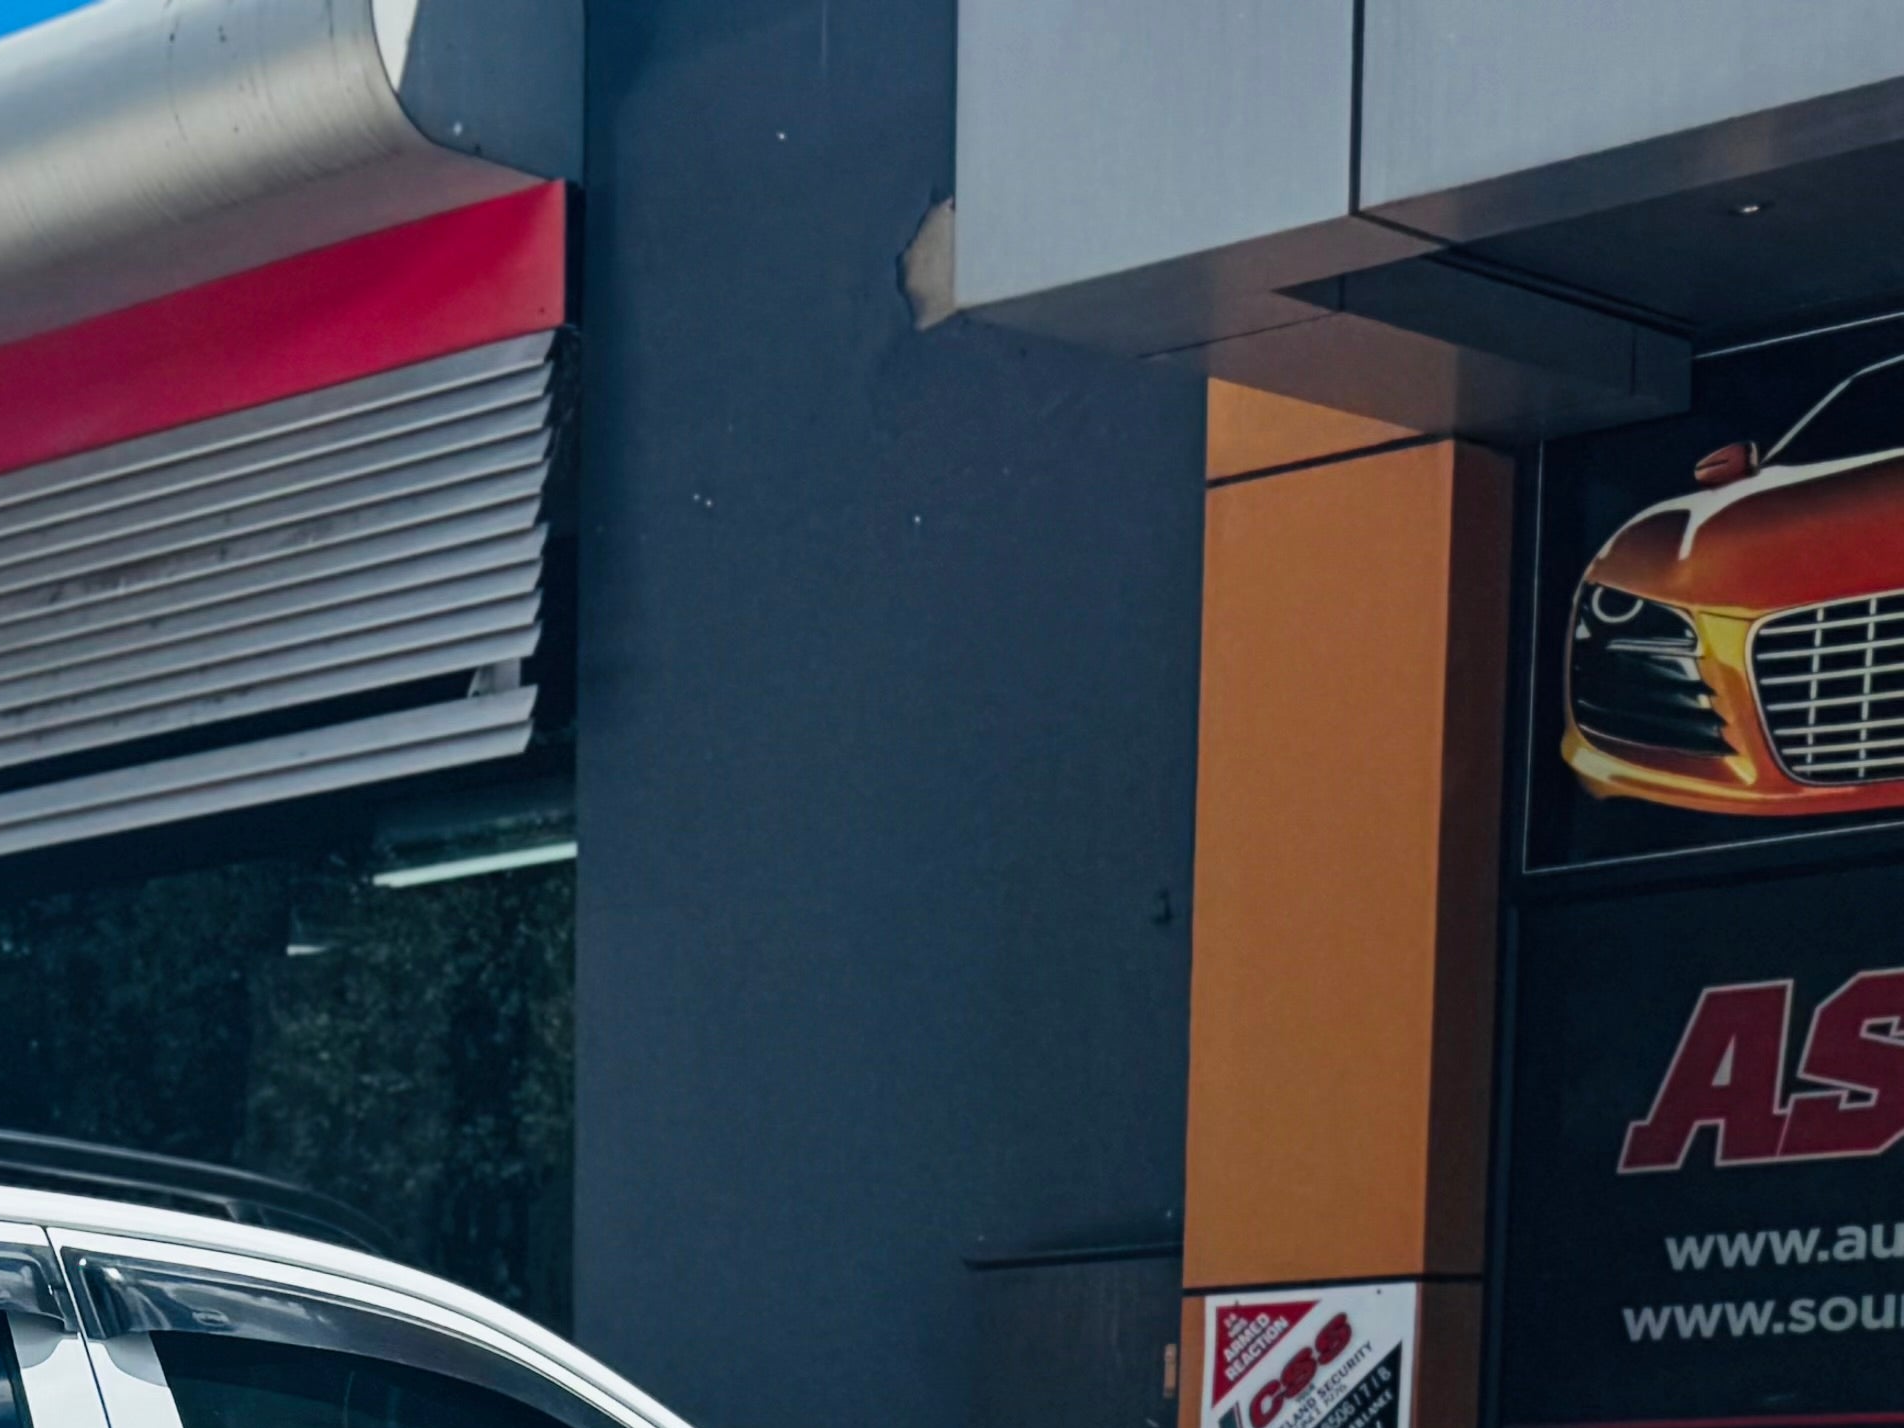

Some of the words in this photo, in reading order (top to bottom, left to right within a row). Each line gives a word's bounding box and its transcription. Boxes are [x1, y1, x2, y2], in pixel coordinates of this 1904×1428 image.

[1223, 1313, 1270, 1362] ARMED
[1622, 1293, 1904, 1342] www.sou
[1224, 1316, 1290, 1381] REACTION
[1317, 1340, 1374, 1397] SECURITY
